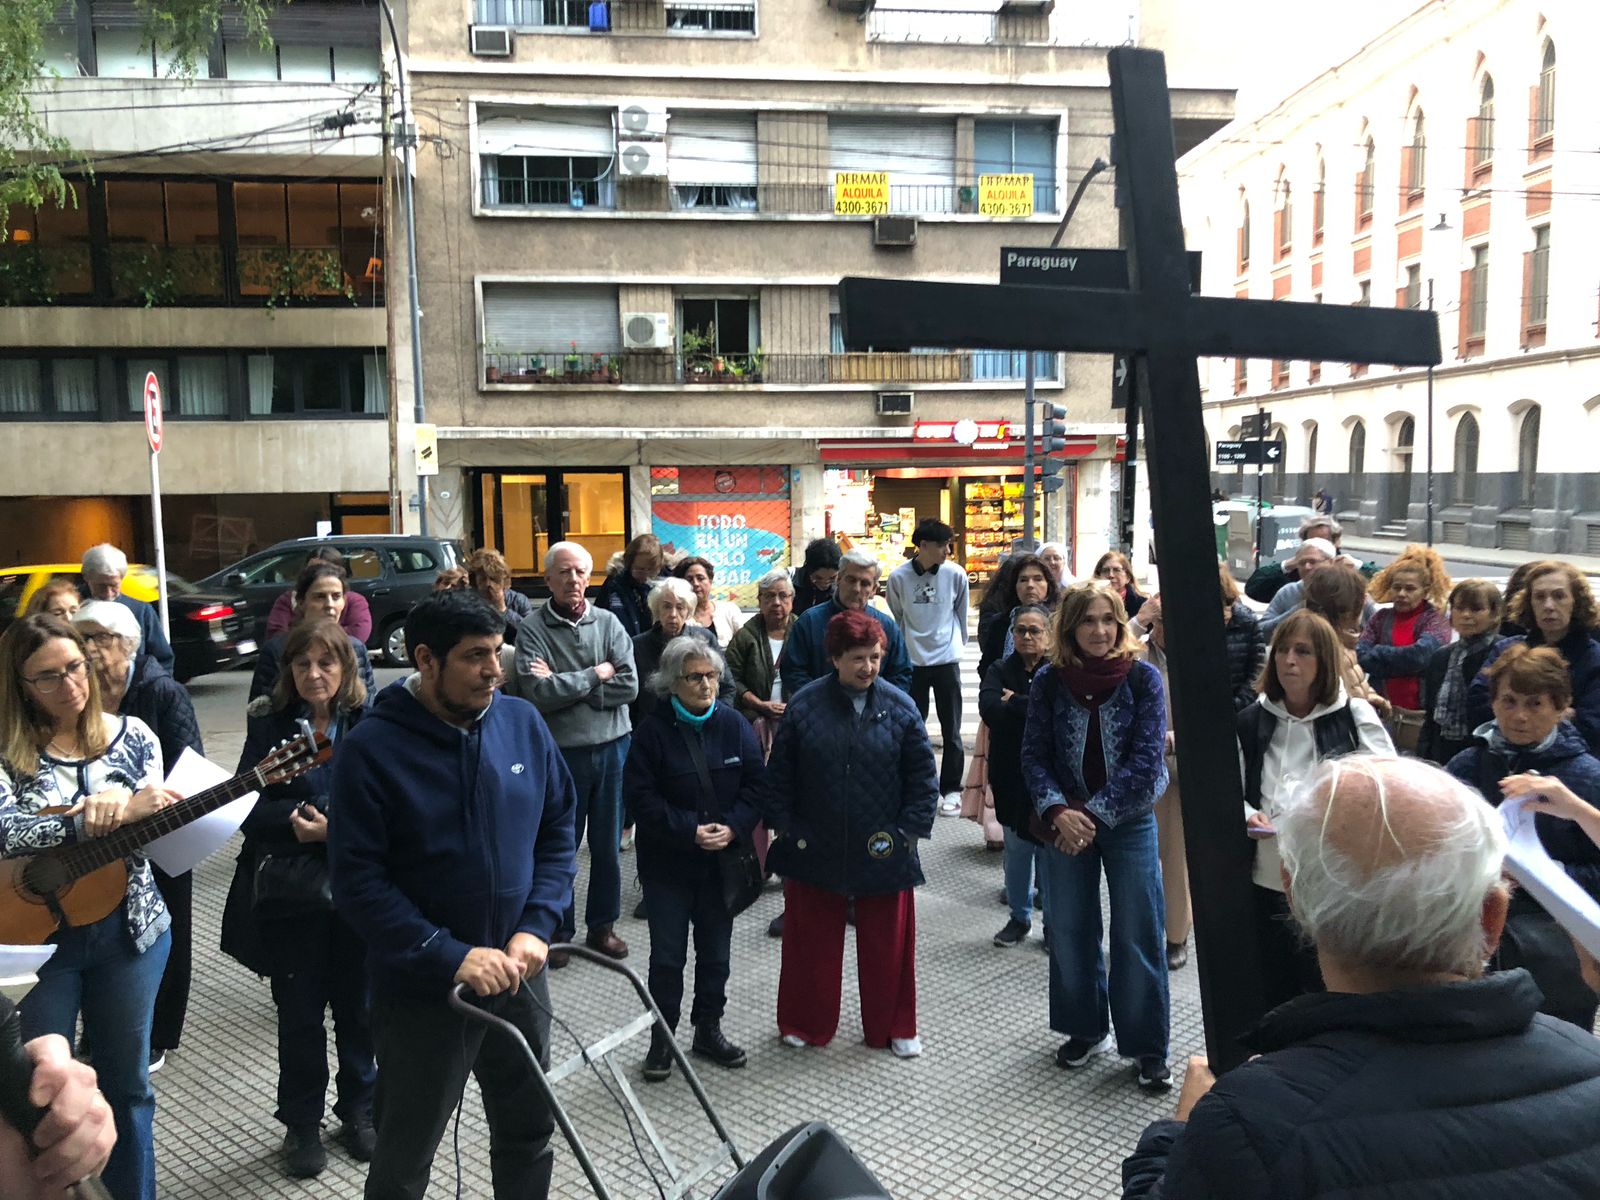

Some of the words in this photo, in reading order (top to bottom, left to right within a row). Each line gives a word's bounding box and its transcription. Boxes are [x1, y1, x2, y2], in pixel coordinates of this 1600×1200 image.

[836, 173, 886, 185] DERMAR
[843, 188, 883, 199] ALQUILA
[987, 190, 1026, 200] ALQUILA
[835, 201, 888, 214] 4300-3671
[980, 203, 1032, 215] 4300-3671
[1007, 253, 1078, 271] Paraguay
[1218, 442, 1242, 450] Paraguay
[697, 514, 747, 530] TODO
[695, 532, 720, 549] EN
[724, 532, 748, 549] UN
[713, 569, 752, 586] GAR
